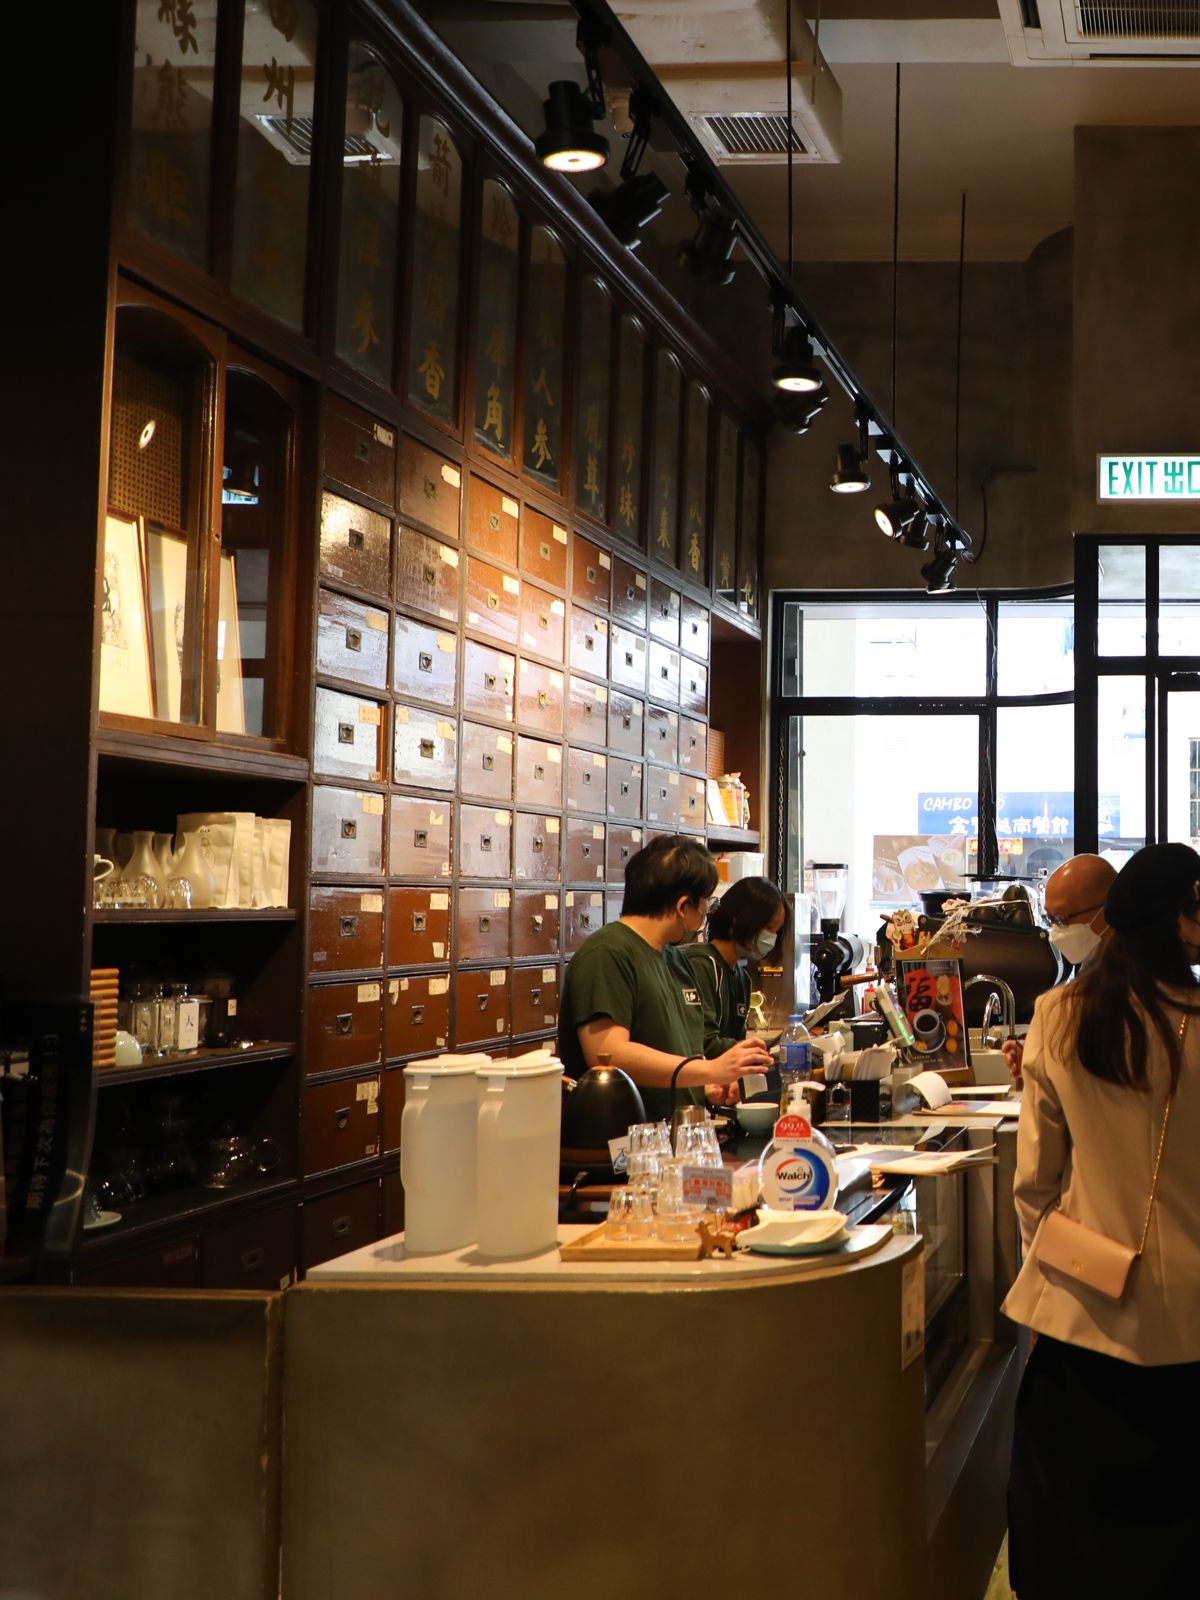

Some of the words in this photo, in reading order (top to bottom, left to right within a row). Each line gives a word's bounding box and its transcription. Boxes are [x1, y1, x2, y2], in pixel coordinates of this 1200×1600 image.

[1108, 461, 1158, 495] EXIT
[923, 797, 972, 811] CAMBO
[777, 1171, 811, 1181] Walch
